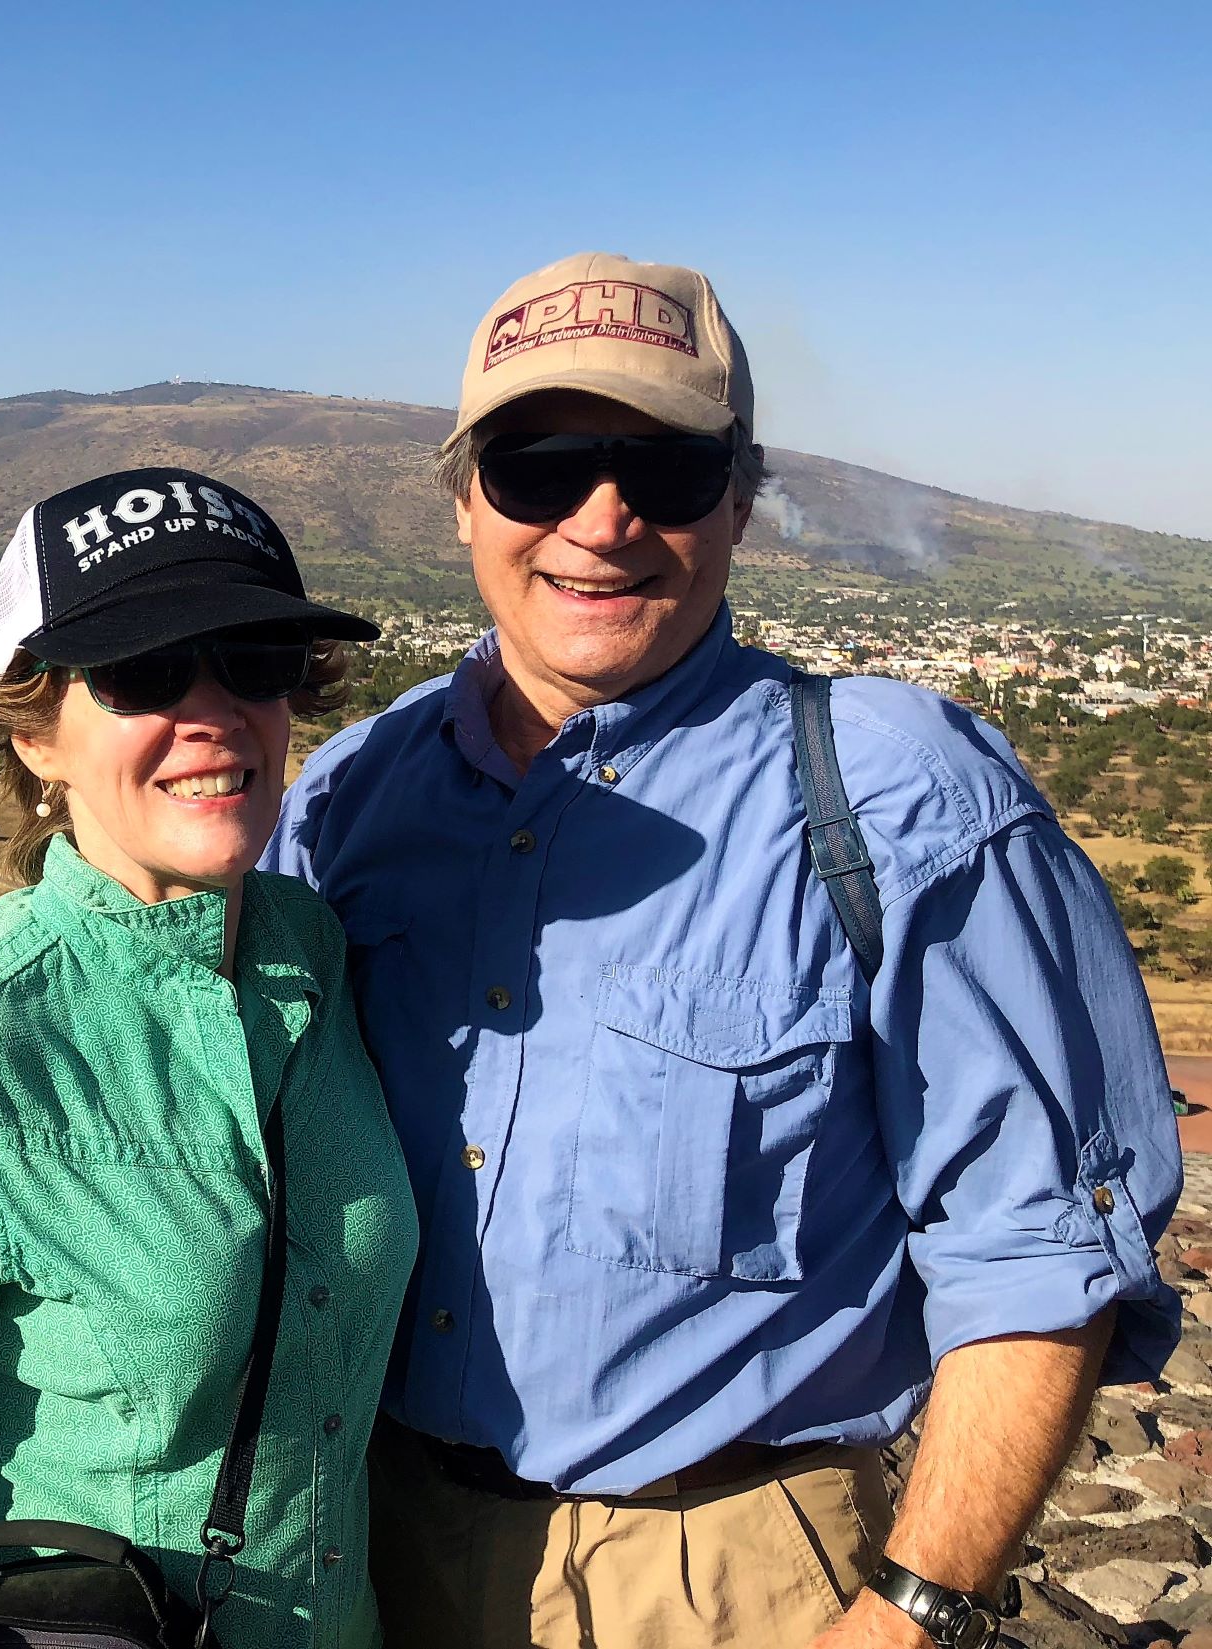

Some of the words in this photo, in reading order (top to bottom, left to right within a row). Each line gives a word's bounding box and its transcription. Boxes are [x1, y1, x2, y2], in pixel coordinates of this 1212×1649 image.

[523, 285, 689, 338] PHD
[538, 325, 596, 346] Hardwood
[597, 323, 666, 345] Distributors
[63, 481, 267, 557] HOIST
[78, 526, 155, 573] STAND
[165, 517, 196, 533] UP
